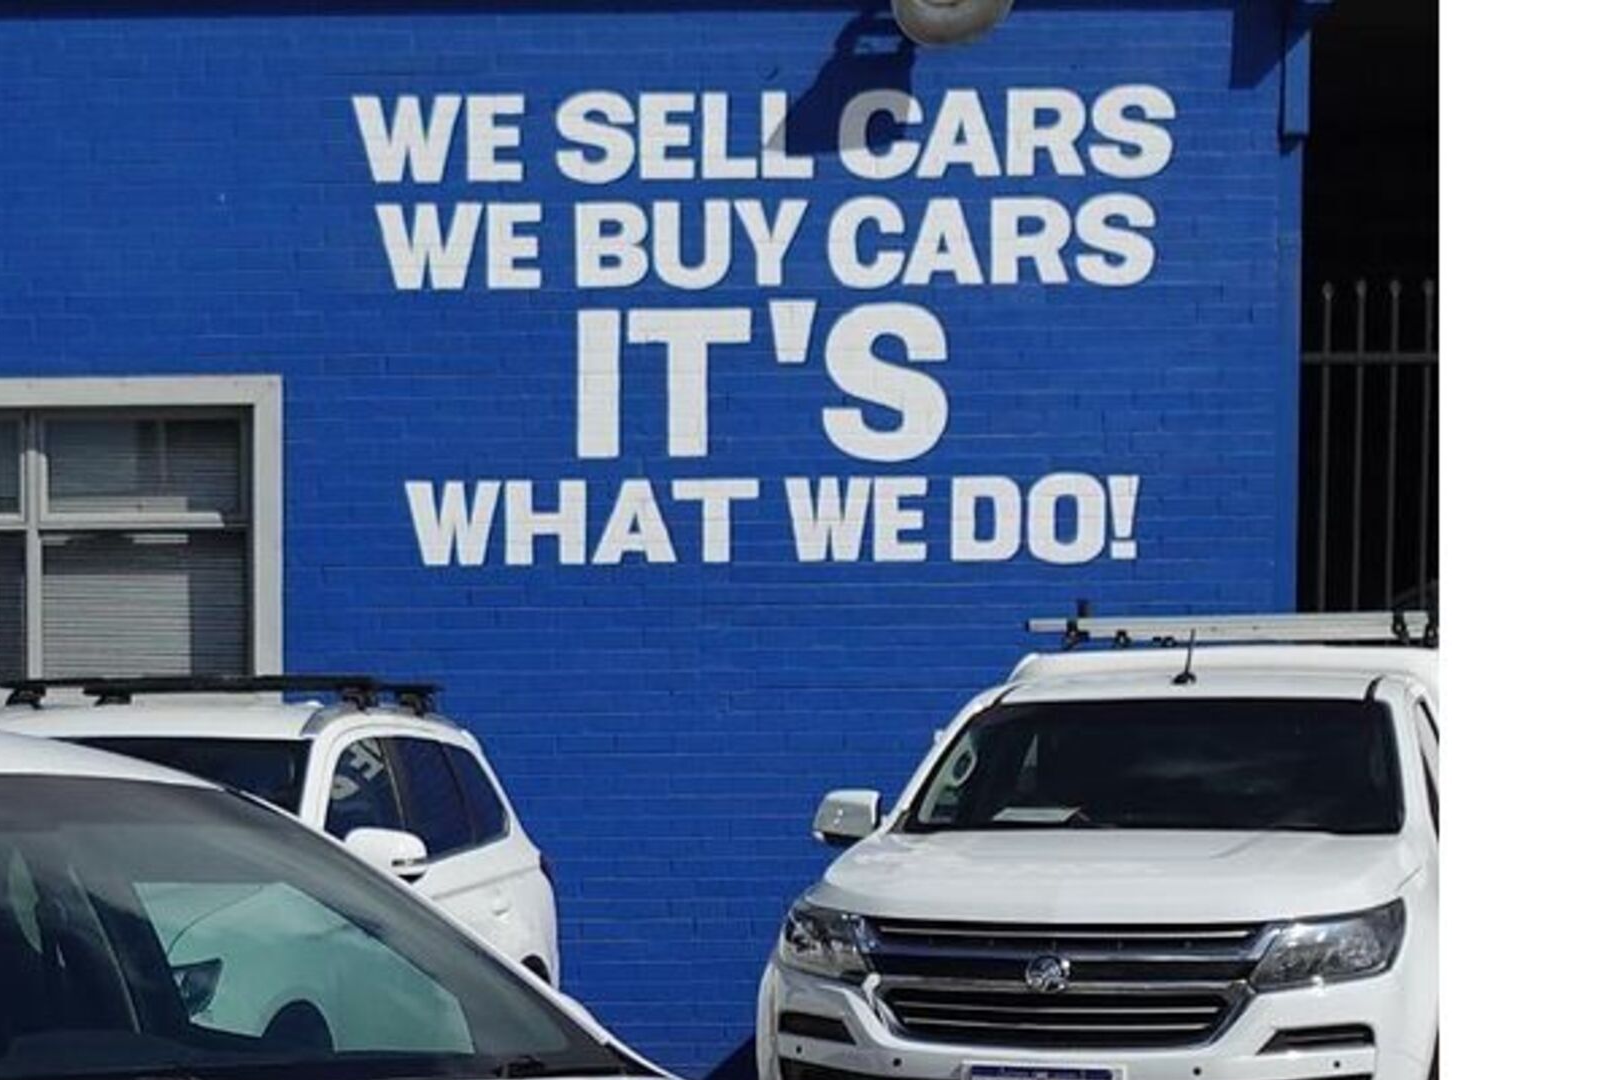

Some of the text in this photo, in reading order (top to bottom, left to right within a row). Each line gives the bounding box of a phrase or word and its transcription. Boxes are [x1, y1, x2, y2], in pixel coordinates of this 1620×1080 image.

[353, 84, 1177, 184] WE SELL CARS
[375, 192, 1157, 290] WE BUY CARS
[577, 299, 949, 462] IT'S
[404, 471, 1140, 566] WHAT WE DO!
